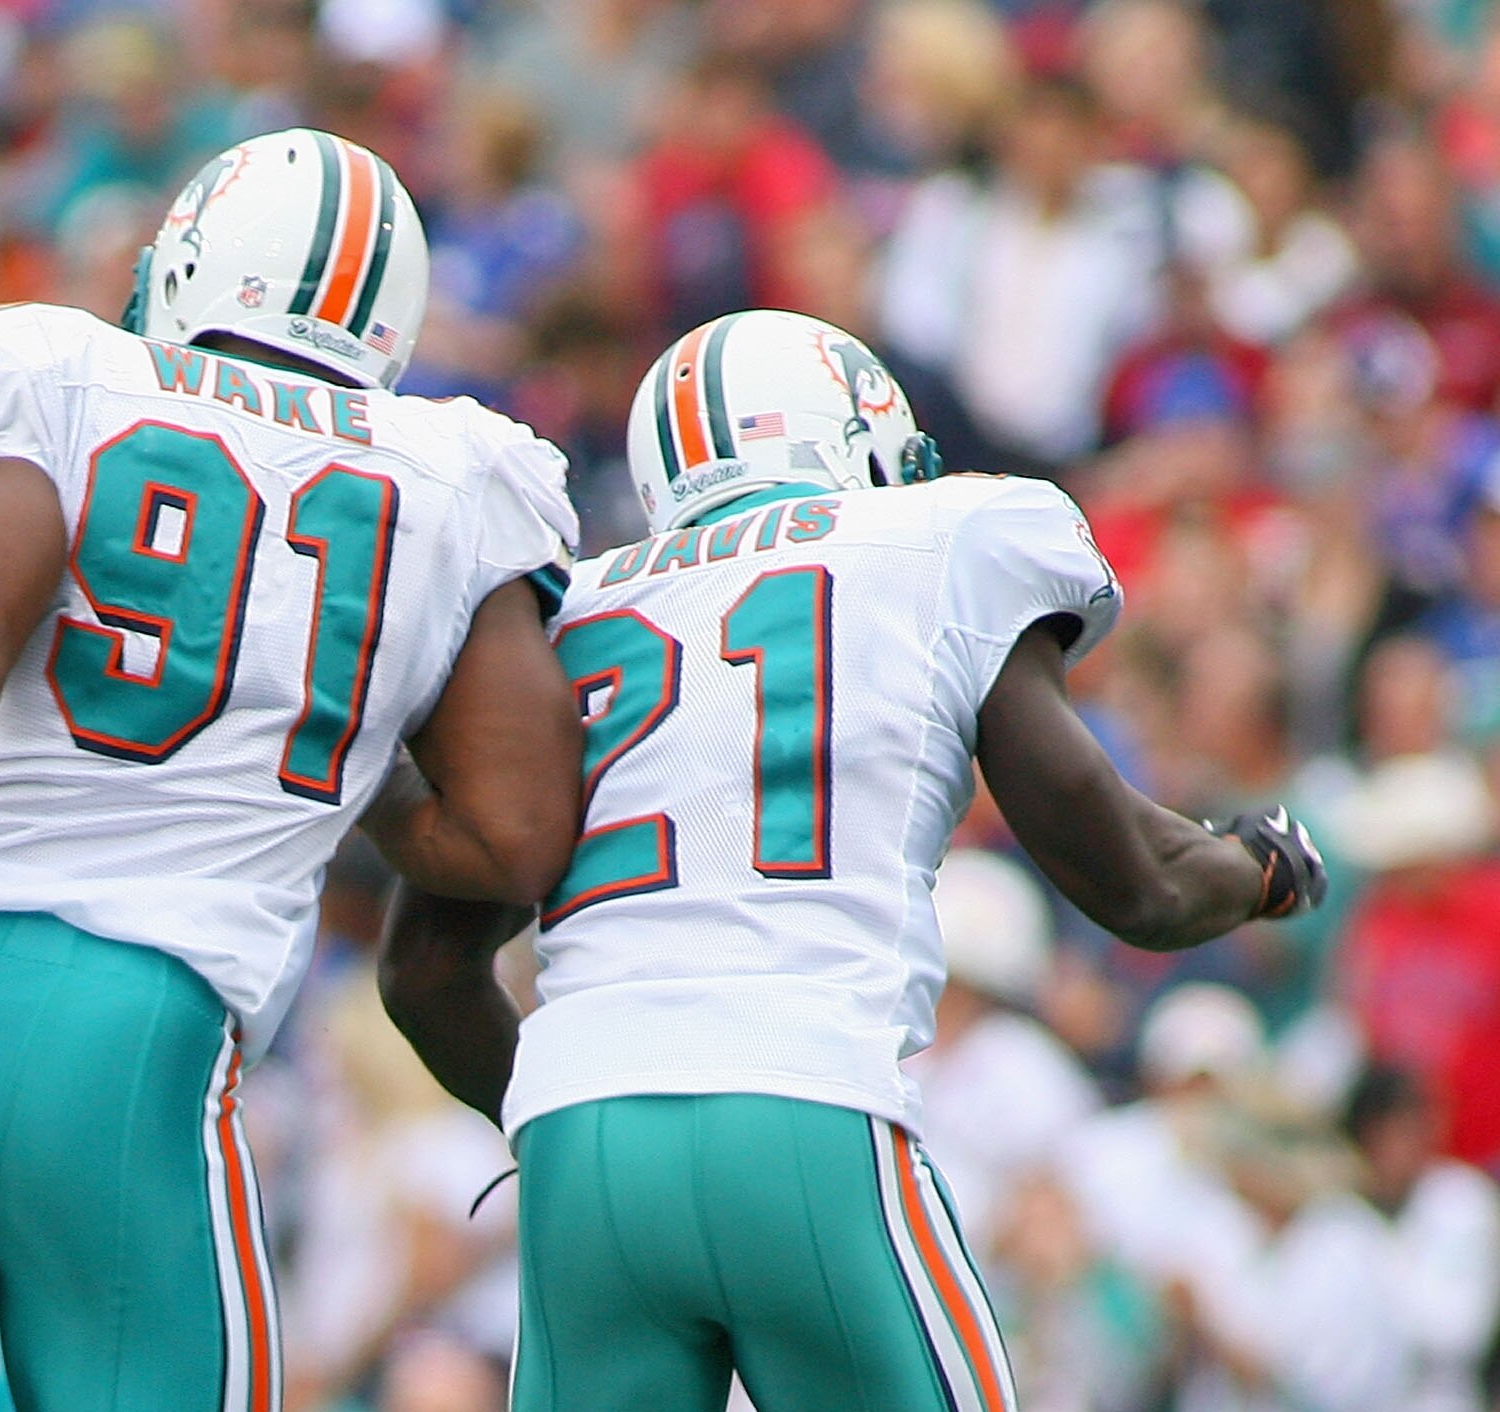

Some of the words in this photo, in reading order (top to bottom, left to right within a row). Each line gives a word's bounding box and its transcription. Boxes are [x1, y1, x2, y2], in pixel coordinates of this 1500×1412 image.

[146, 342, 372, 445] WAKE
[44, 418, 399, 806] 91
[599, 500, 842, 588] DAVIS
[540, 565, 833, 933] 21
